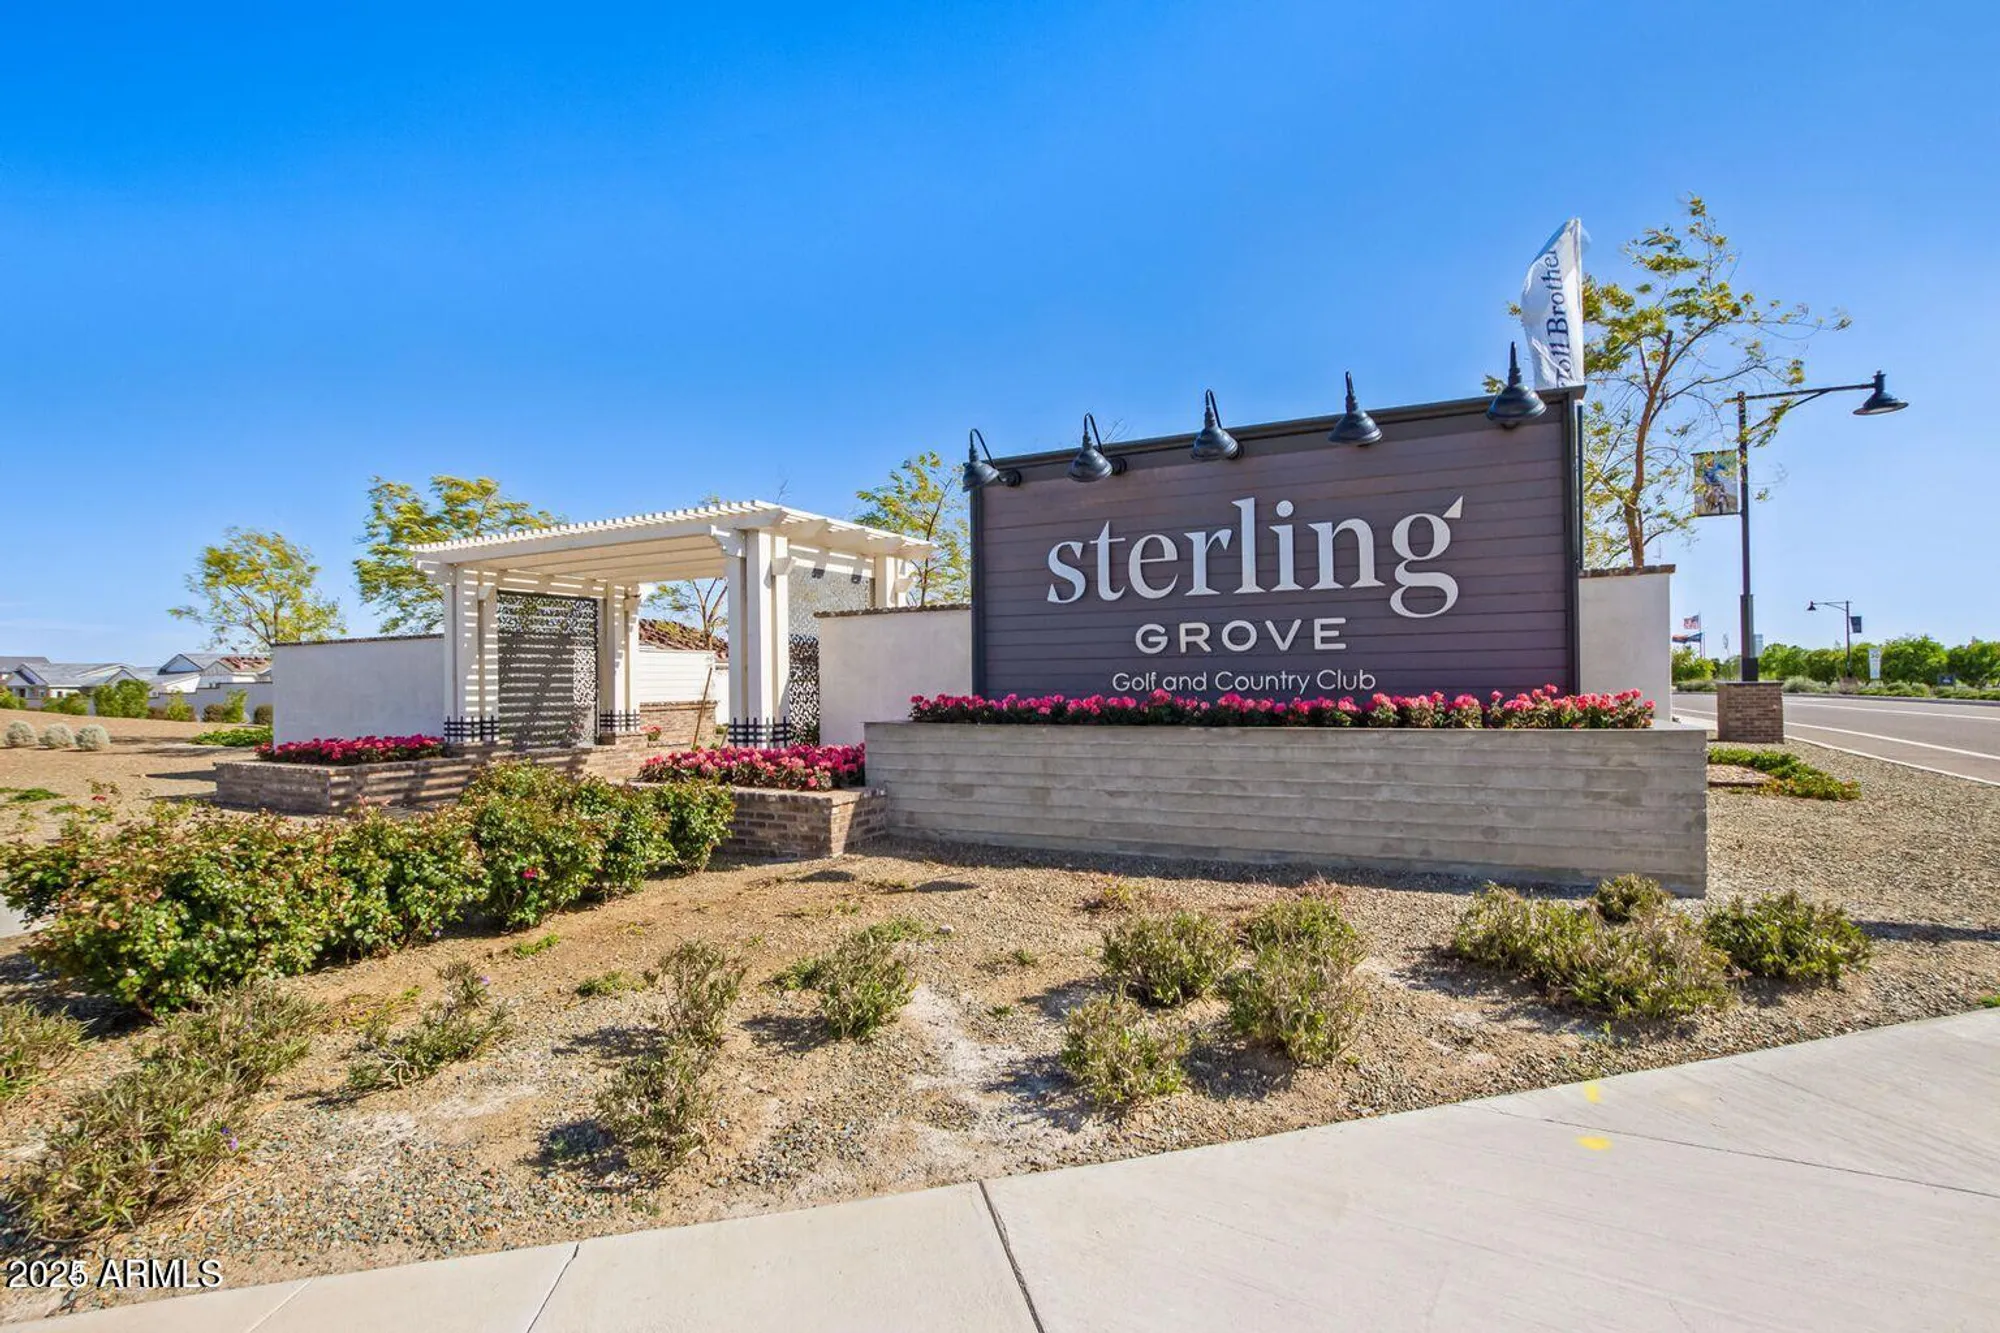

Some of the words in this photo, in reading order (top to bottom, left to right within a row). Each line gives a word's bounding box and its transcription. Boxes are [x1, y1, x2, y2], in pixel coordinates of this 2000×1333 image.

[1047, 495, 1464, 618] sterling
[1135, 617, 1347, 654] GROVE
[1112, 671, 1158, 692] Golf
[1162, 672, 1207, 691] and
[1215, 670, 1310, 694] Country
[1316, 669, 1376, 690] Club
